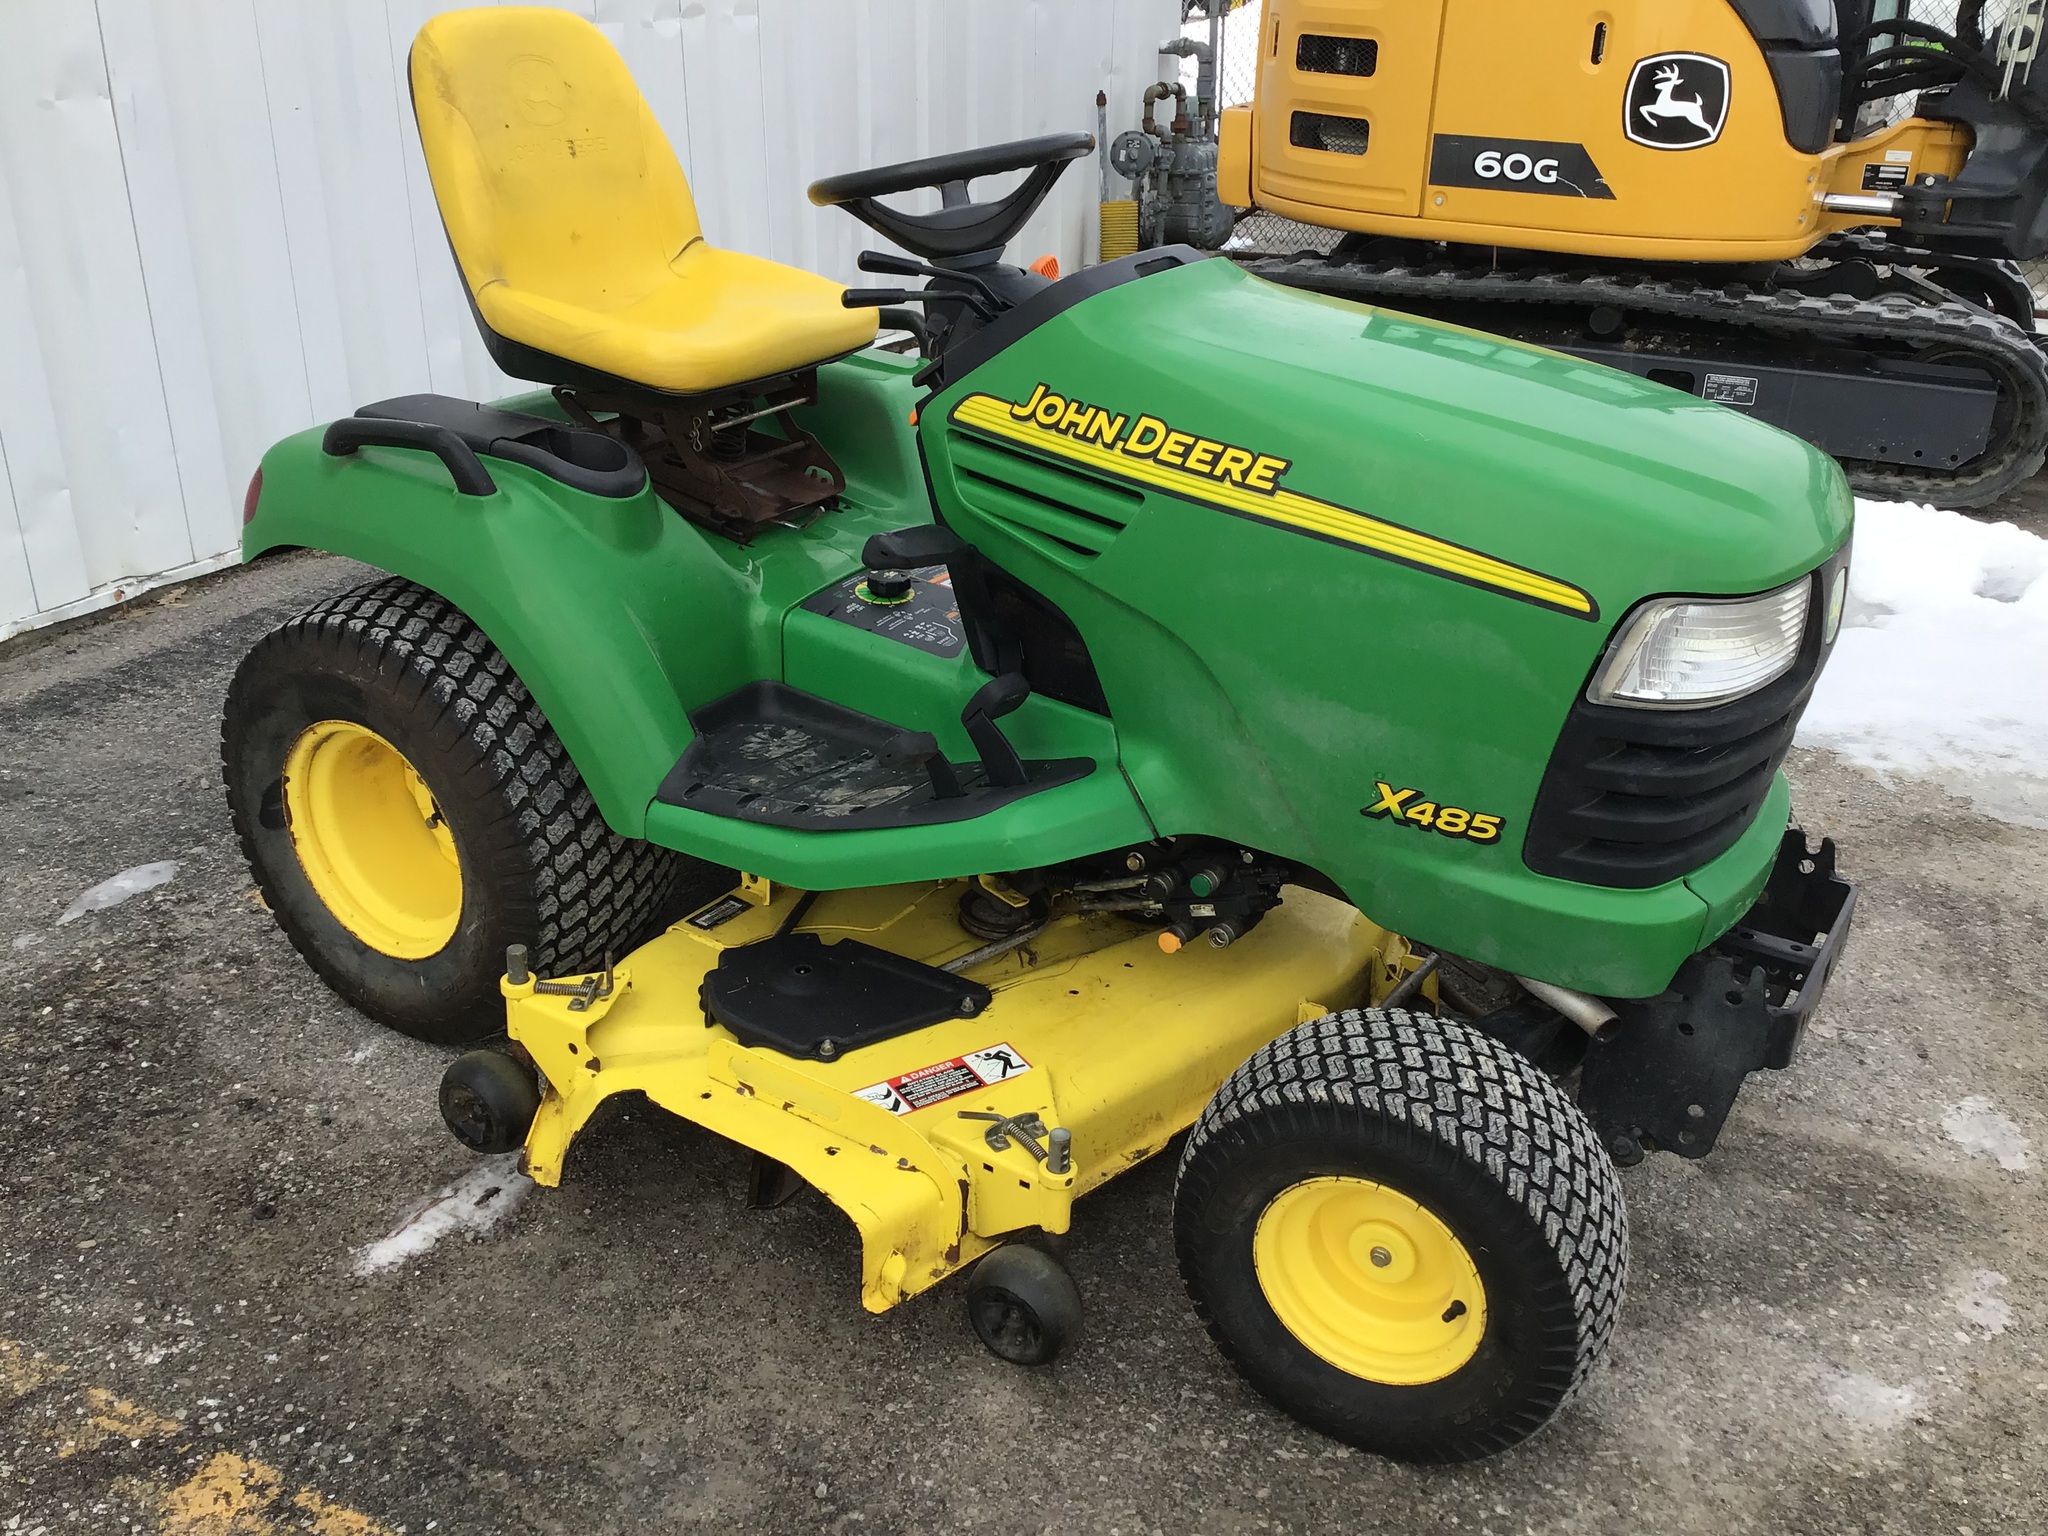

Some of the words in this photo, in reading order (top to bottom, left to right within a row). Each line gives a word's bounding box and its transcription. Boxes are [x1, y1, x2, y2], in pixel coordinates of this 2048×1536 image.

[1473, 150, 1560, 184] 60G
[1009, 383, 1126, 447] JOHN
[1124, 414, 1289, 493] DEERE
[1363, 780, 1503, 841] X485
[909, 1061, 955, 1080] DANGER
